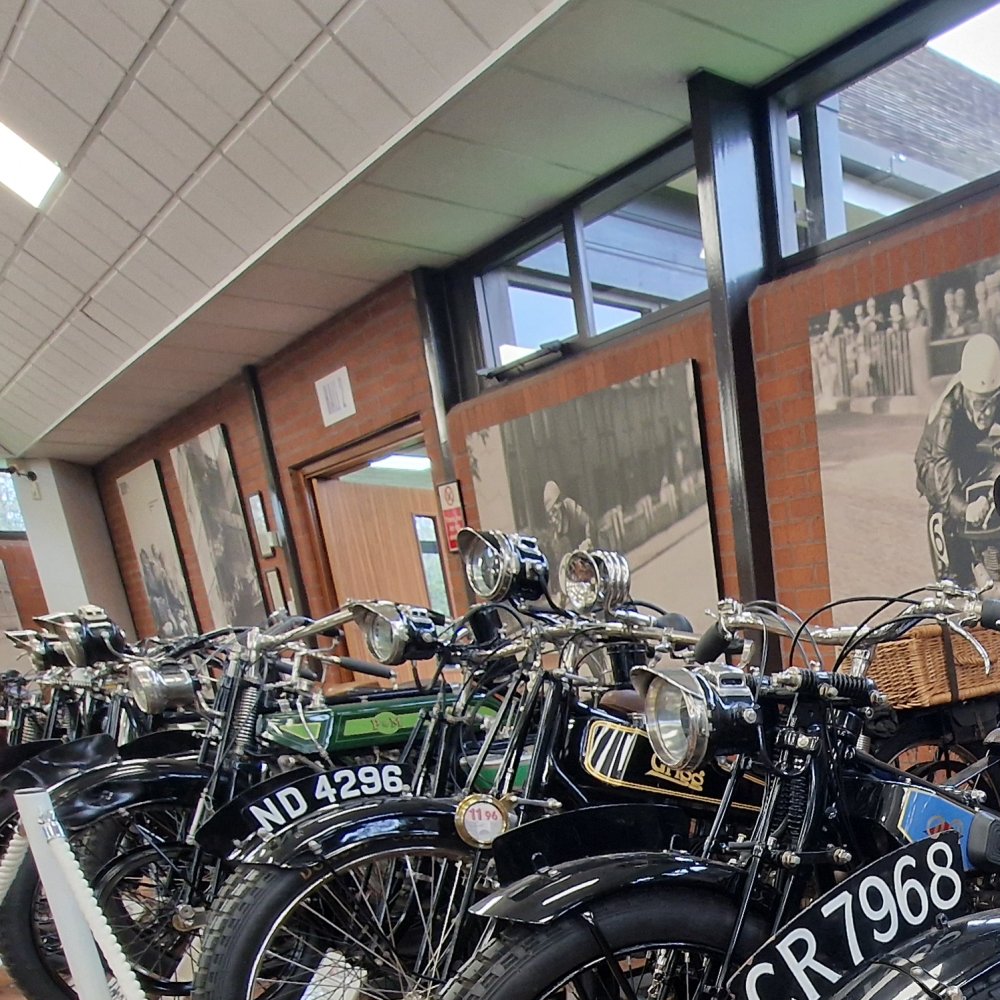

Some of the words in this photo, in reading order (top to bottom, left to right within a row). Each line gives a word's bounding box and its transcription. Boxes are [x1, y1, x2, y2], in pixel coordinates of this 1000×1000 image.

[249, 786, 309, 833] ND
[315, 764, 404, 824] 4296
[819, 839, 963, 969] 7968
